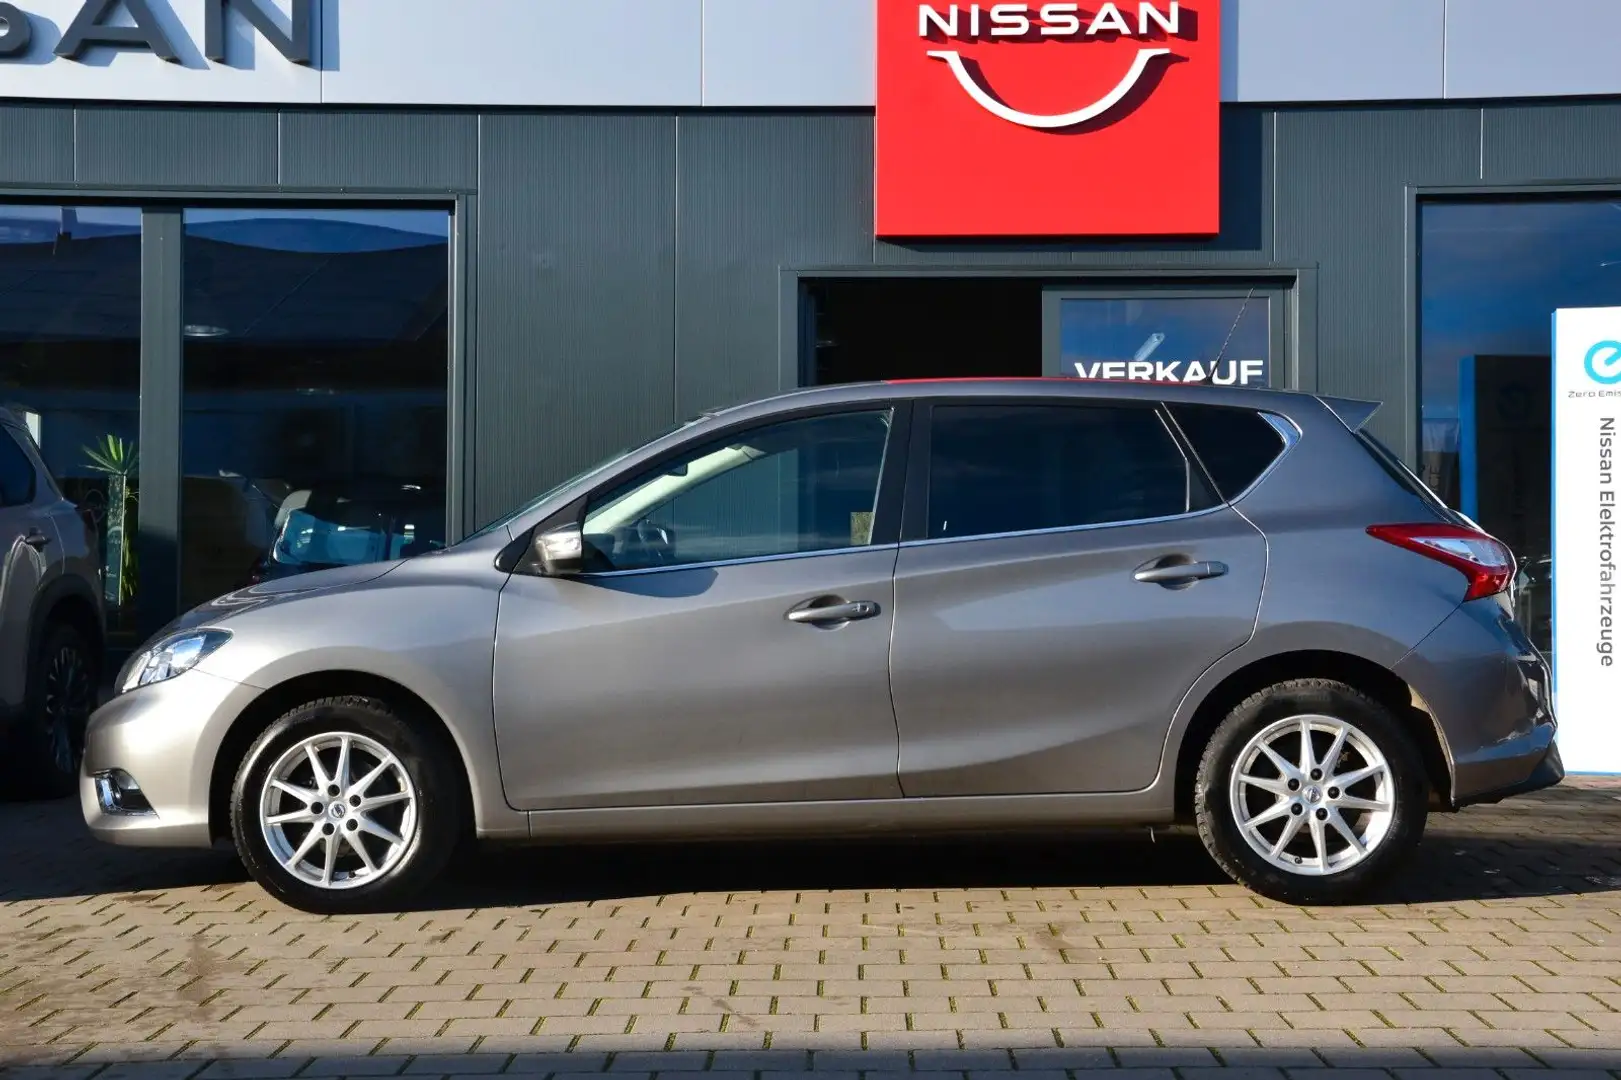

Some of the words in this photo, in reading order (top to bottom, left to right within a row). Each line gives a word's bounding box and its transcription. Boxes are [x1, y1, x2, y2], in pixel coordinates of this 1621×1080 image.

[0, 0, 311, 62] AN
[918, 2, 1179, 37] NISSAN
[1074, 360, 1264, 385] VERKAUF
[1568, 390, 1596, 398] Zero
[1600, 417, 1616, 484] Nissan
[1596, 491, 1616, 667] Elektrofahrzeuge
